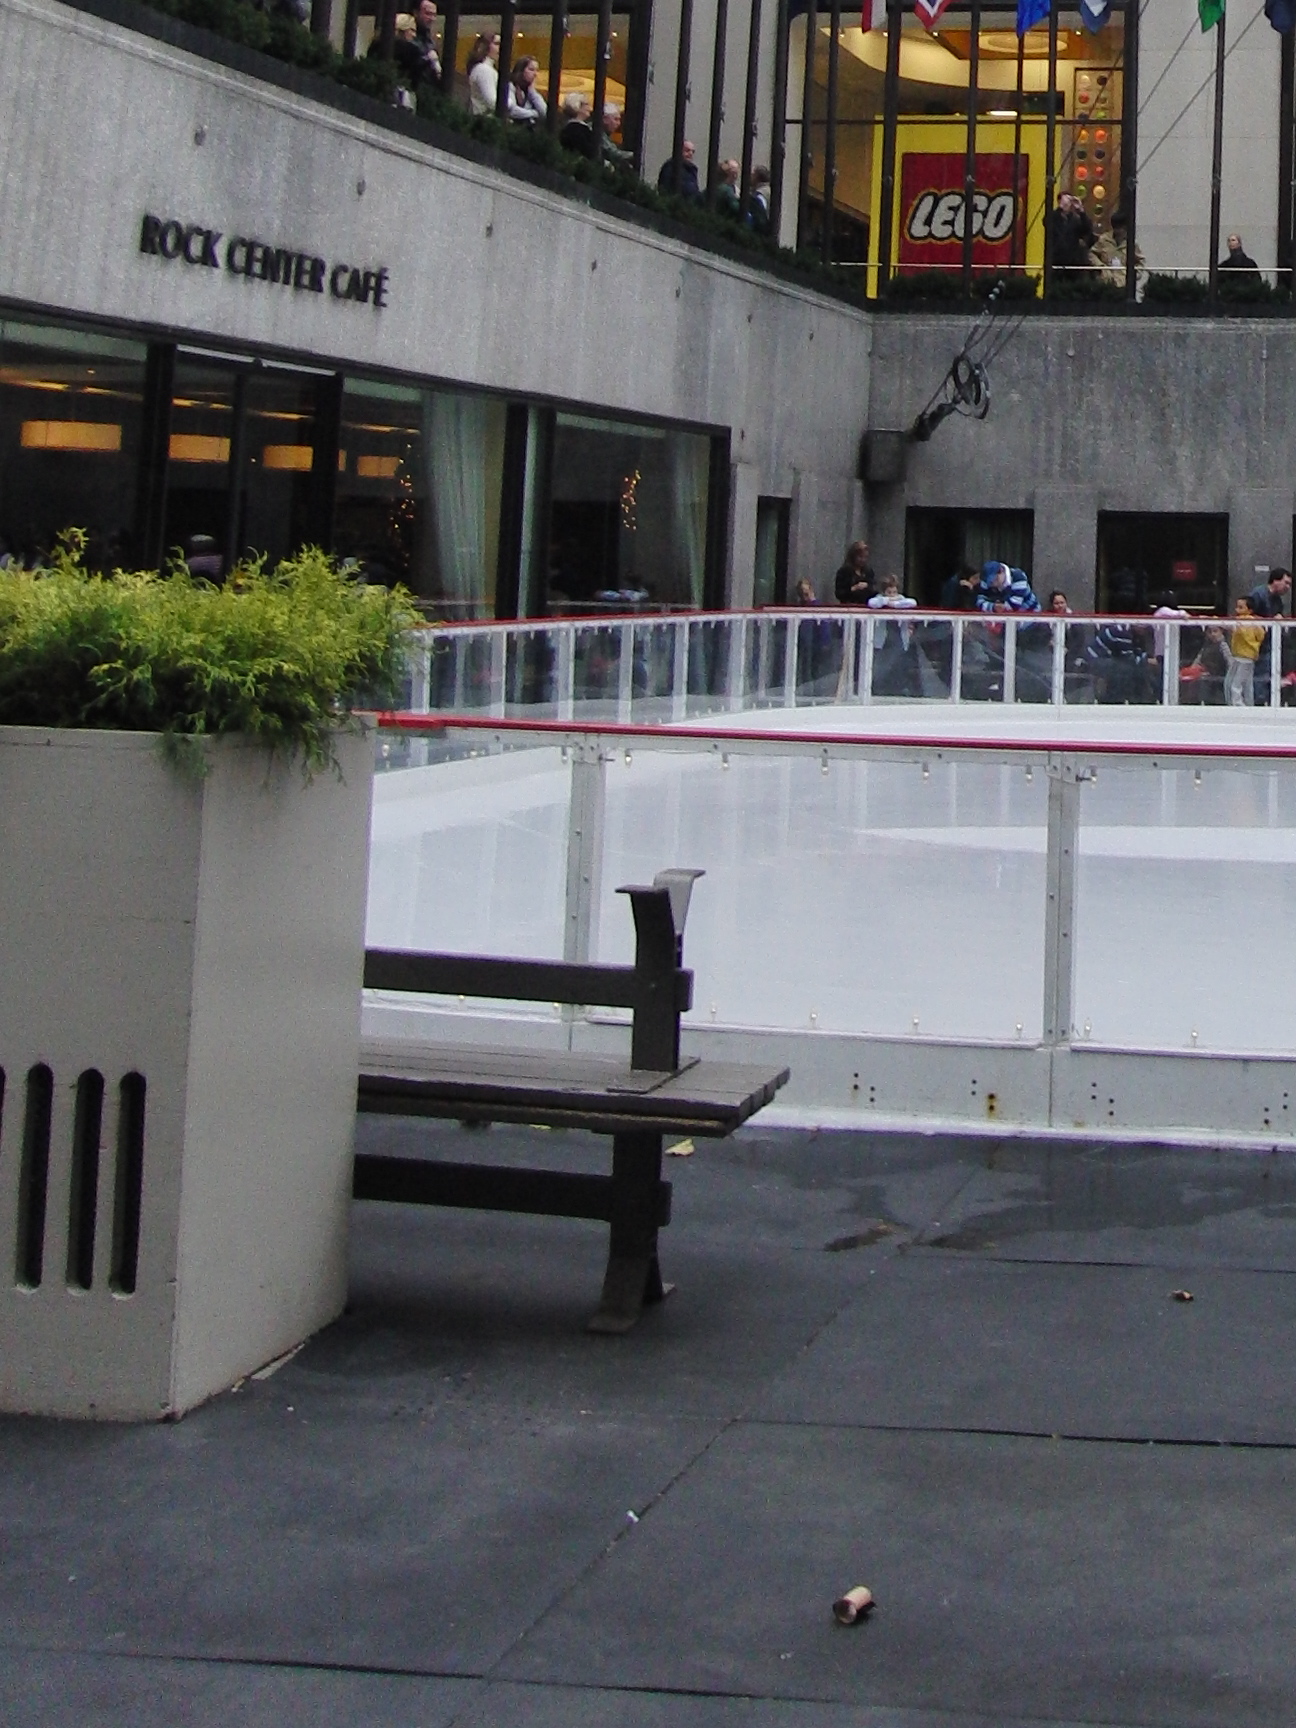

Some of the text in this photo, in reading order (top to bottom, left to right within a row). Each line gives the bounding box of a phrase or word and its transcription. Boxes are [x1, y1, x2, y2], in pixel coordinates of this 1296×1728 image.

[908, 191, 1017, 240] LEGO
[139, 213, 390, 308] ROCK CENTER CAFÉ
